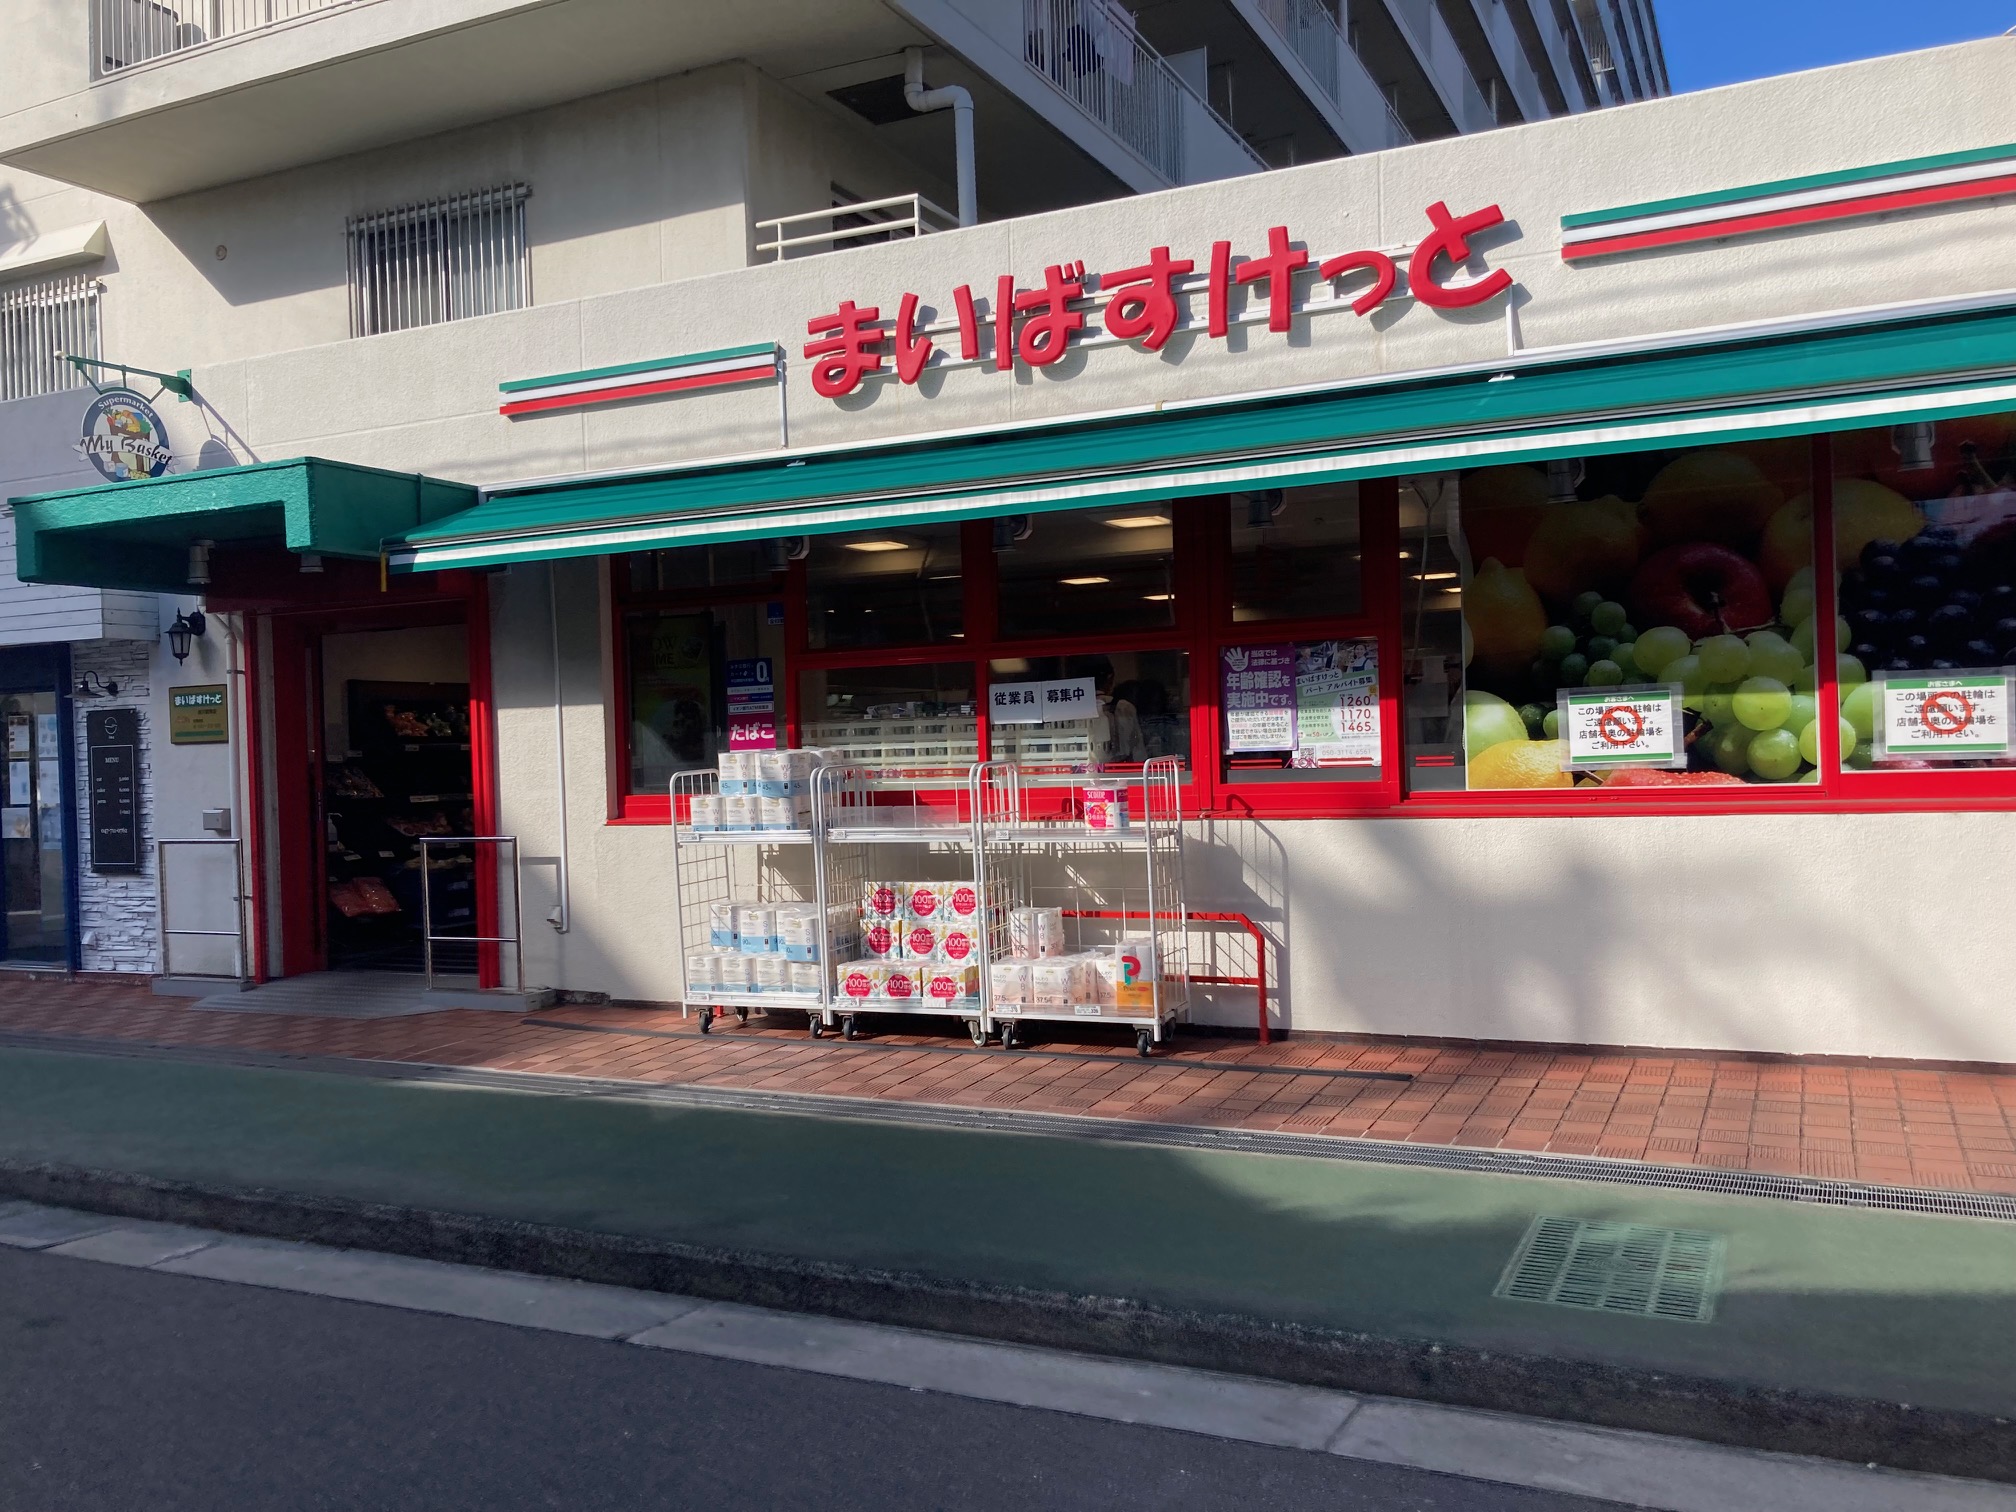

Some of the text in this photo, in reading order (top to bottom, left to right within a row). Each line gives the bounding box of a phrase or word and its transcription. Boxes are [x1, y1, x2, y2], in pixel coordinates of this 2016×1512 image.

[804, 200, 1513, 399] まいばすけっと
[97, 397, 154, 419] Supermarket
[79, 434, 173, 466] My Basket
[1251, 649, 1277, 657] 当店では
[1251, 657, 1290, 666] 法律に基づき
[1227, 670, 1290, 690] 年齢確認を
[1305, 686, 1323, 694] パート
[175, 694, 222, 706] まいばすけっと
[994, 687, 1085, 706] 従業員 募集中
[1227, 690, 1292, 708] 実施中です。
[1896, 690, 1995, 701] この場所への駐輪は
[1578, 704, 1662, 715] この場所への駐輪は
[731, 722, 774, 741] たばこ
[914, 895, 928, 904] 100
[955, 894, 969, 902] 100
[912, 933, 926, 942] 100
[947, 938, 962, 947] 100
[848, 978, 863, 987] 100
[889, 979, 904, 988] 100
[933, 981, 948, 990] 100
